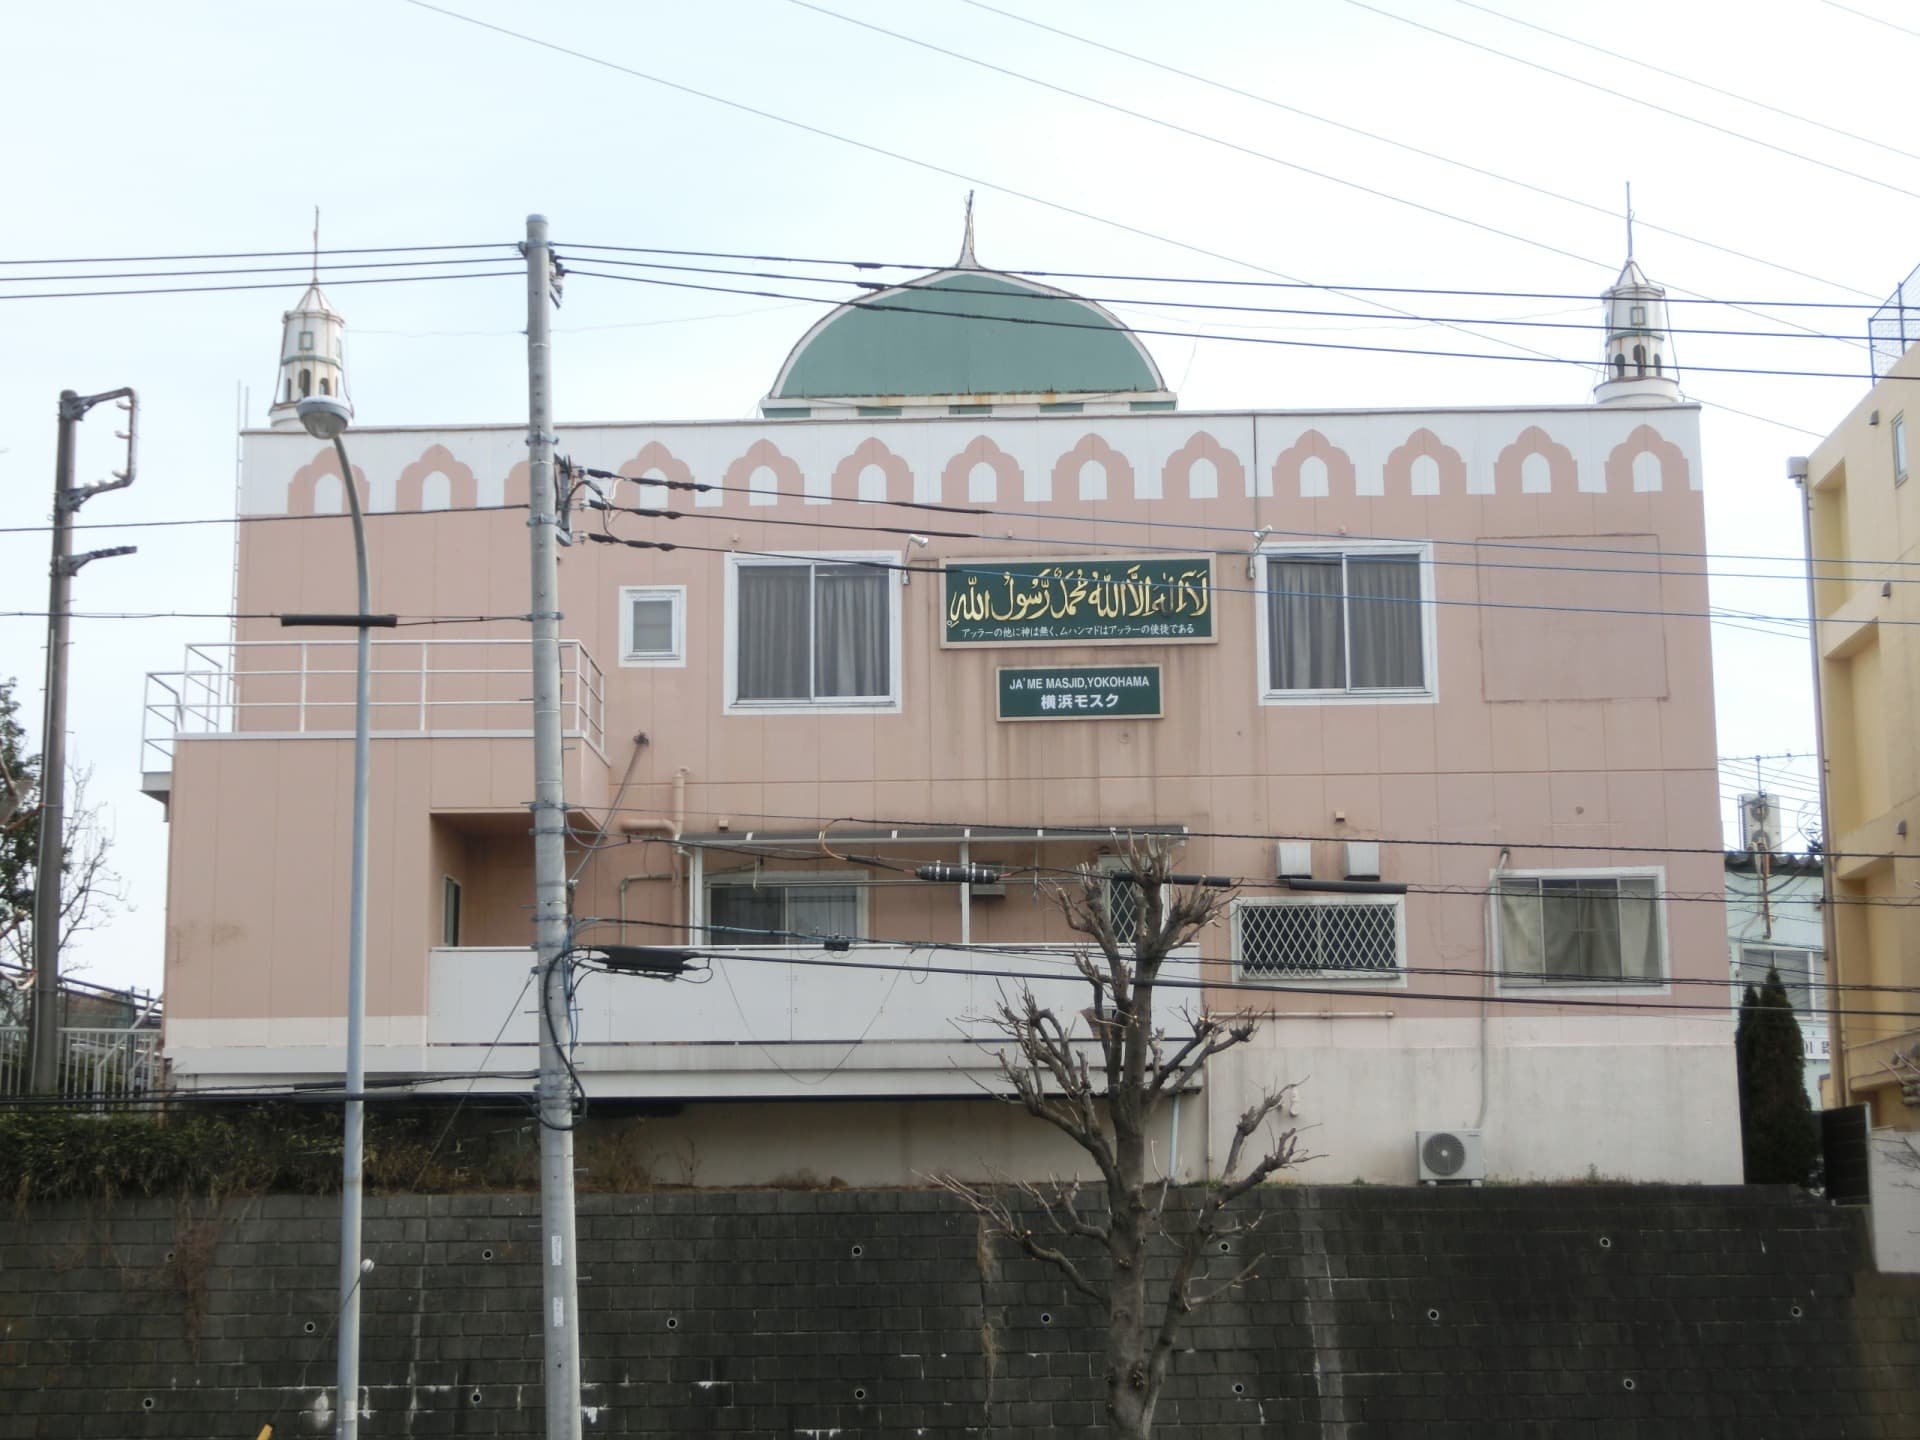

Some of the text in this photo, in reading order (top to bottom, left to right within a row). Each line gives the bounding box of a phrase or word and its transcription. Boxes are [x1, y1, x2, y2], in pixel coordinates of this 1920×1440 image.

[1041, 693, 1119, 710] 横浜モスク
